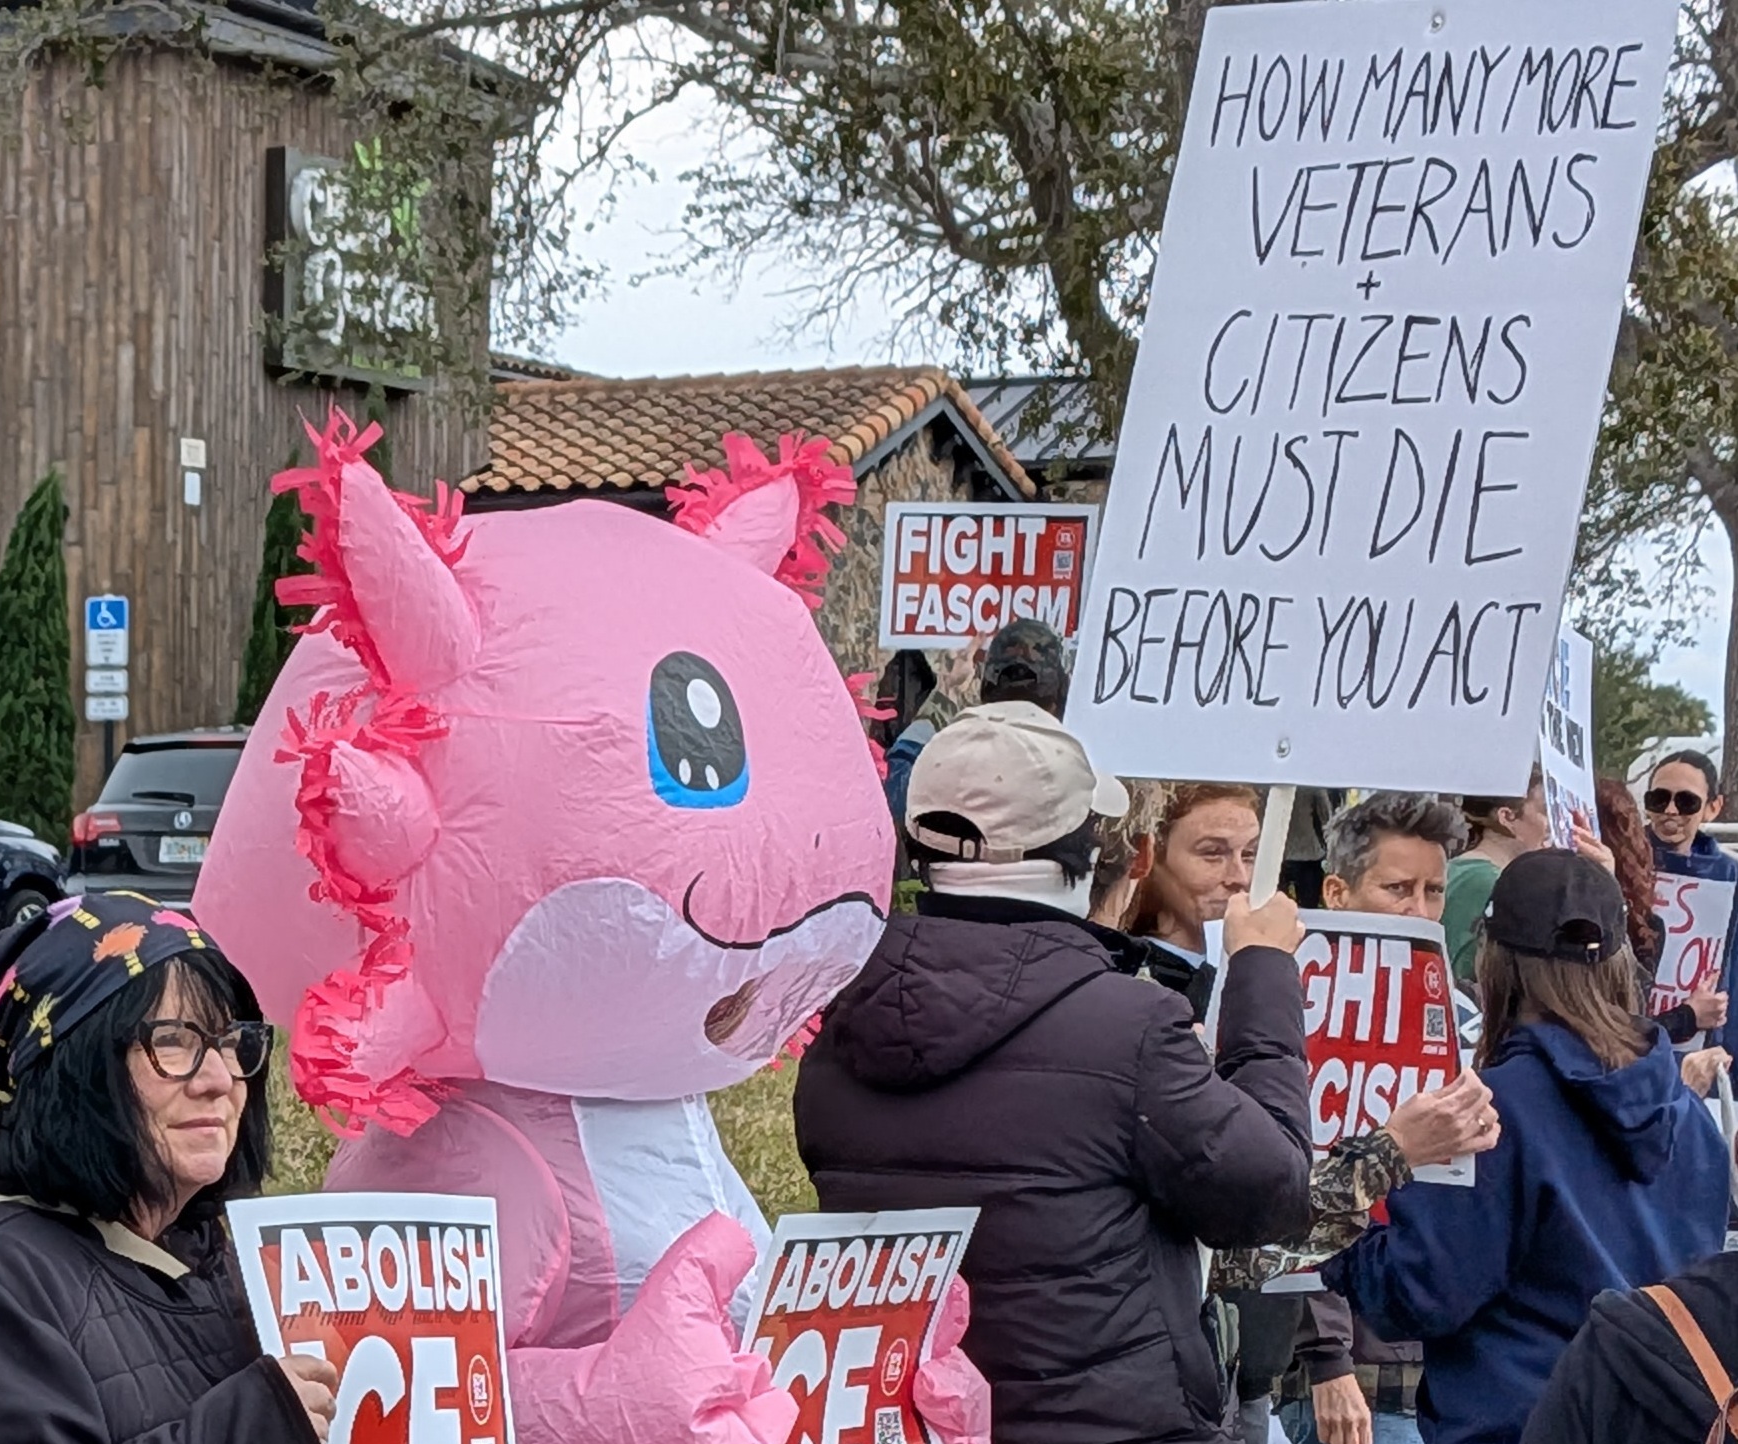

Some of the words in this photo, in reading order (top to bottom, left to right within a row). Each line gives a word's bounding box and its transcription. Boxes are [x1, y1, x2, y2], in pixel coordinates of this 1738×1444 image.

[1211, 55, 1345, 147] HOW
[1347, 44, 1512, 143] MANY
[1502, 43, 1644, 134] MORE
[1252, 153, 1598, 267] VETERANS
[1356, 272, 1382, 301] +
[1204, 309, 1533, 418] CITIZENS
[1138, 424, 1360, 562] MUST
[1369, 428, 1531, 566] DIE
[898, 515, 1047, 577] FIGHT
[895, 583, 1071, 639] FASCISM
[1093, 588, 1294, 708] BEFORE
[1313, 595, 1416, 711] YOU
[1407, 600, 1543, 717] ACT
[279, 1224, 496, 1317] ABOLISH
[764, 1232, 962, 1317] ABOLISH
